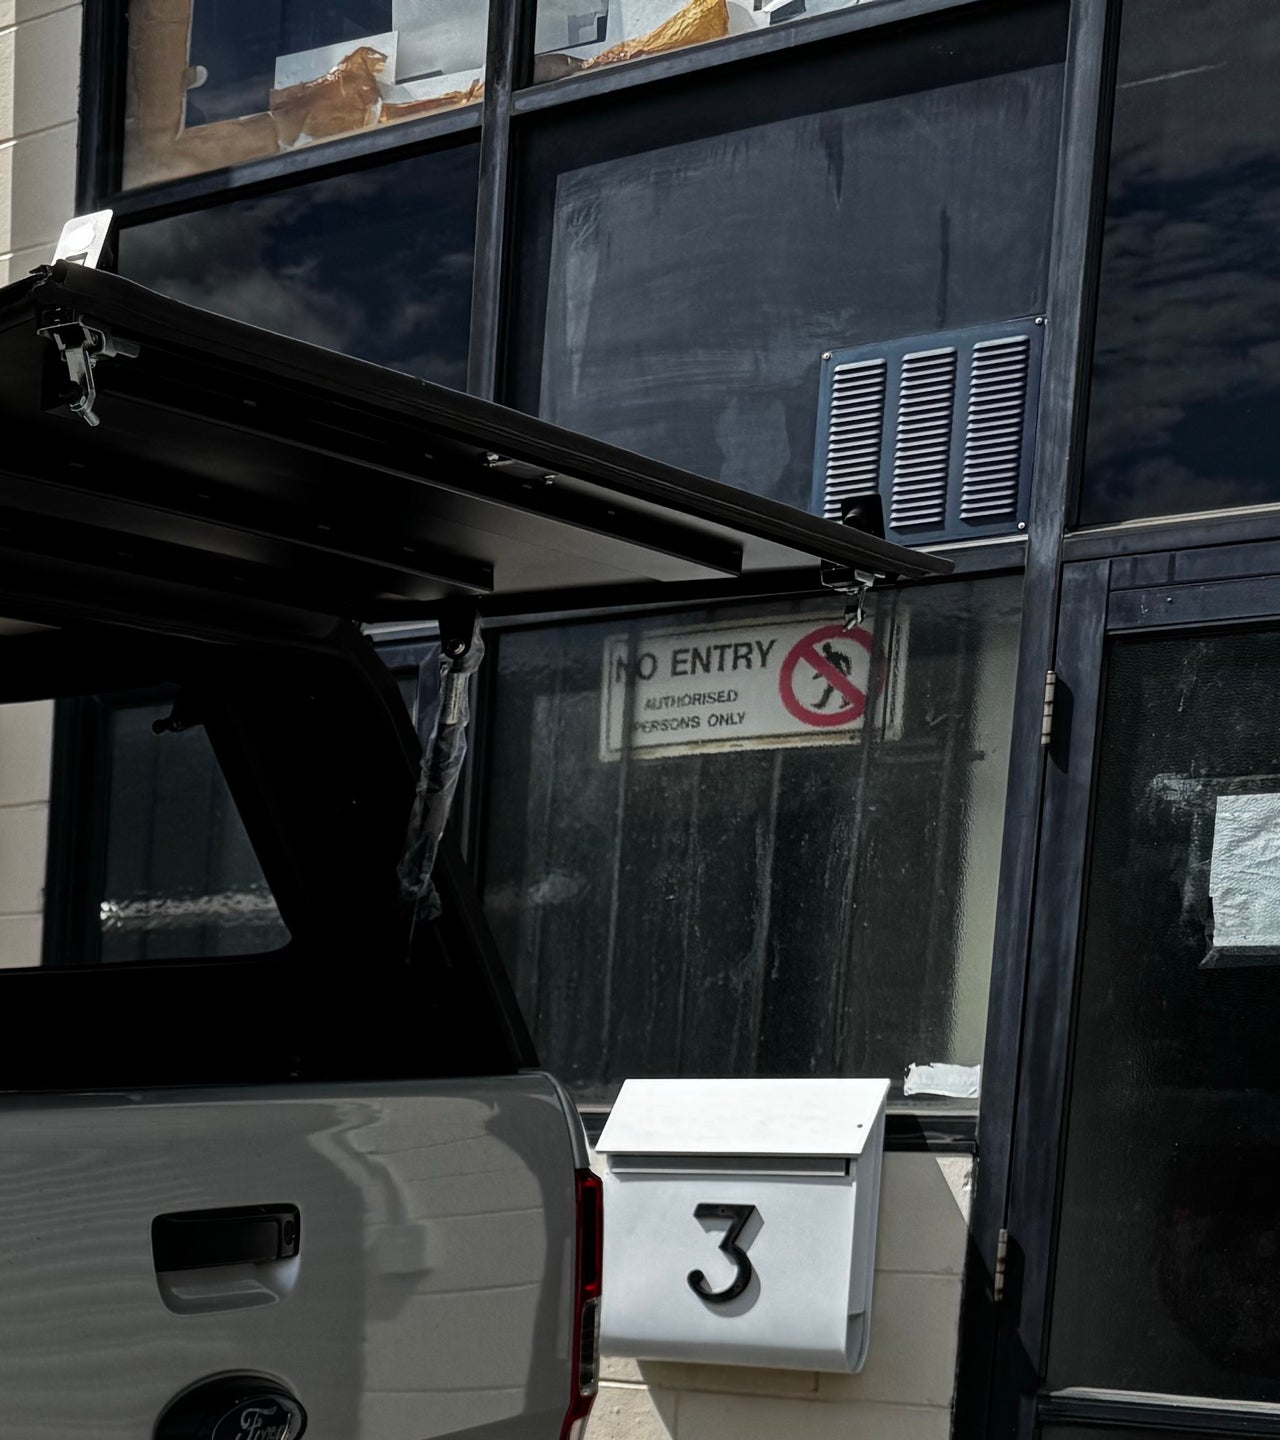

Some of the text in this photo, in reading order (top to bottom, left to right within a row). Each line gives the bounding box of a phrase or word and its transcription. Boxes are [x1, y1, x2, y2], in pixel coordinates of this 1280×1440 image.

[670, 639, 778, 677] ENTRY
[643, 690, 738, 711] AUTHORISED
[707, 711, 746, 728] ONLY
[687, 1203, 756, 1302] 3
